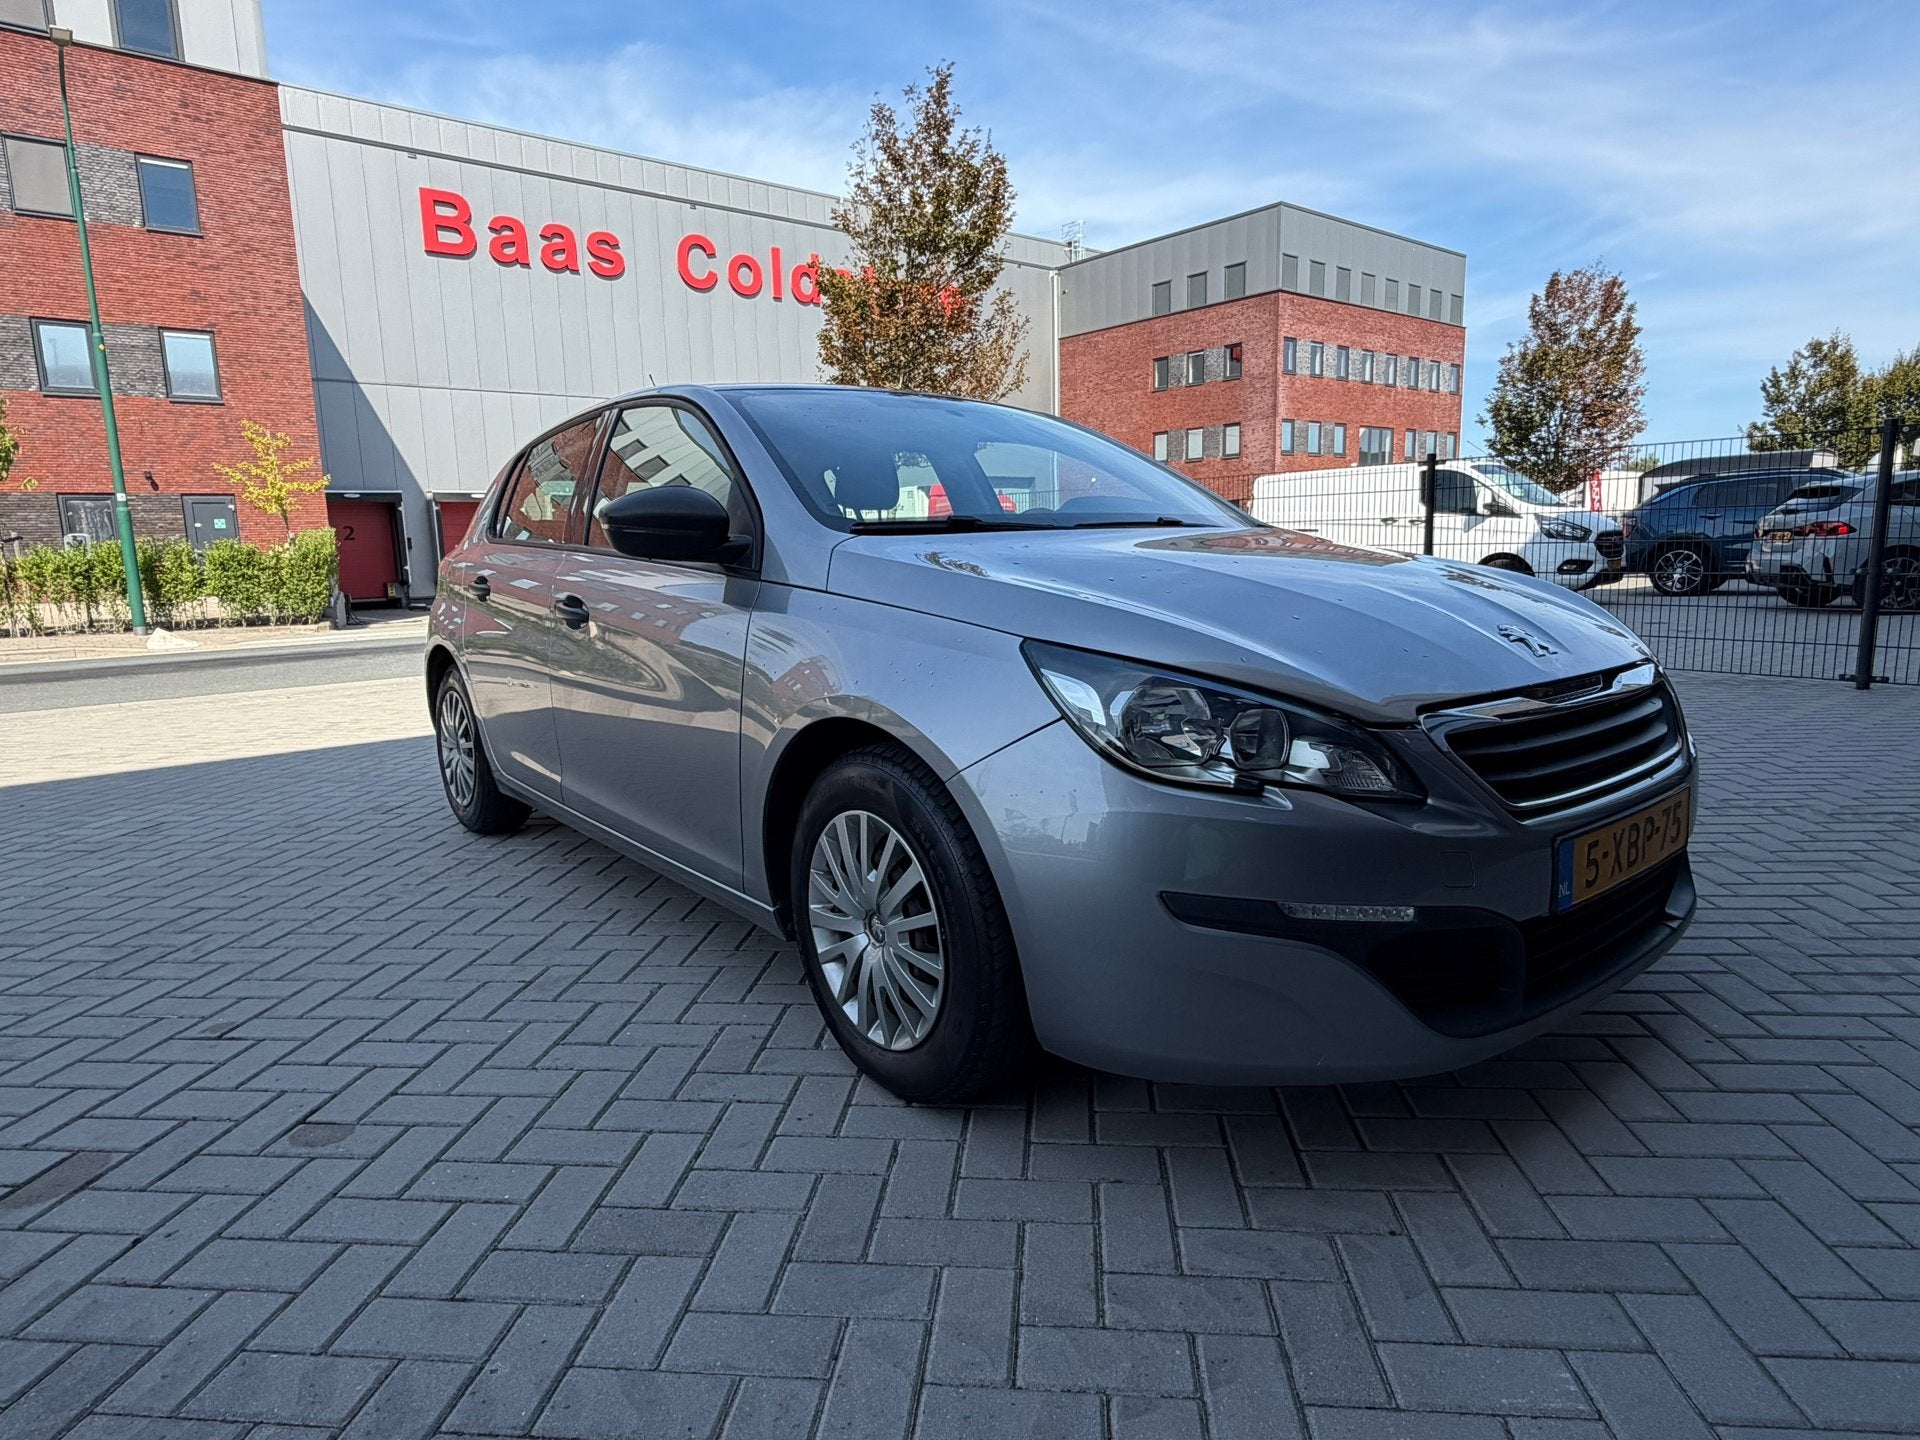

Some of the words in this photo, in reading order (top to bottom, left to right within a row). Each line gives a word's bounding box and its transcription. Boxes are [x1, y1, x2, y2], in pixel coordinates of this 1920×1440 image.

[420, 187, 627, 278] Baas
[343, 525, 355, 540] 2
[1585, 802, 1682, 888] 5-XBP-75
[1558, 882, 1571, 898] NL
